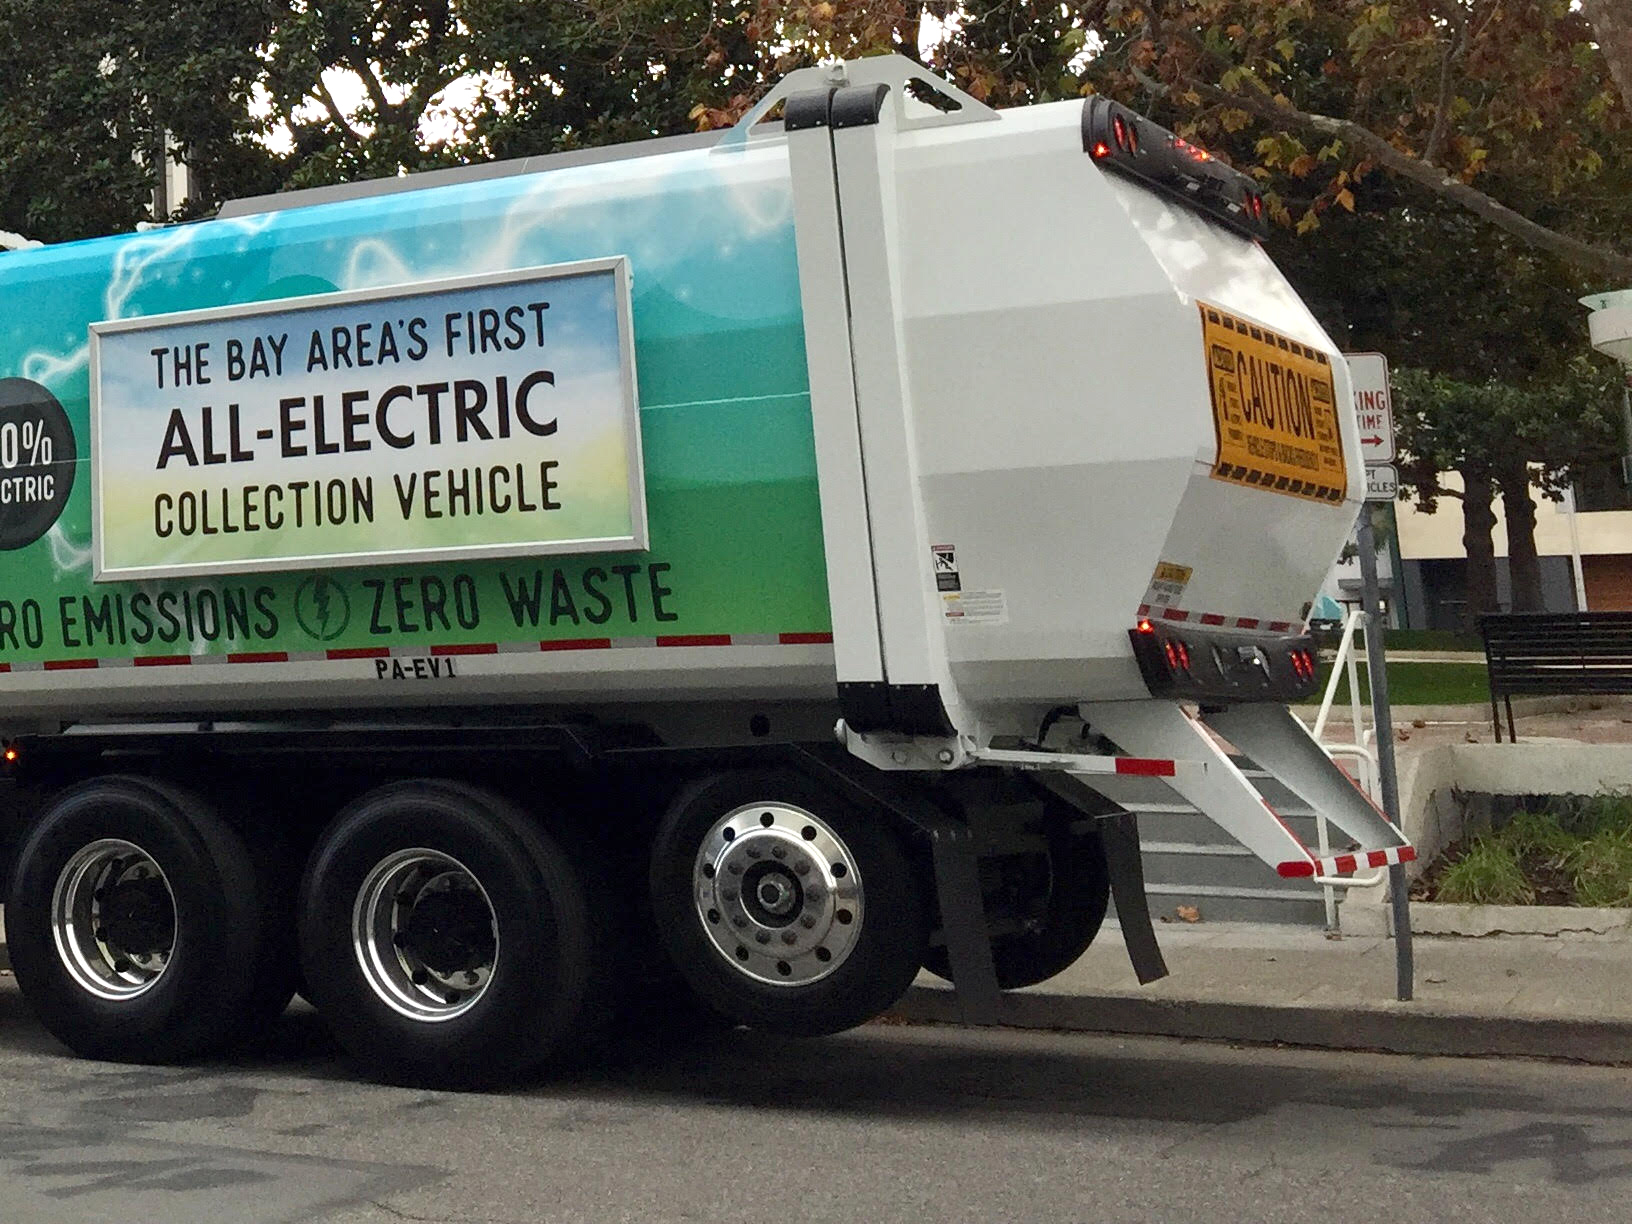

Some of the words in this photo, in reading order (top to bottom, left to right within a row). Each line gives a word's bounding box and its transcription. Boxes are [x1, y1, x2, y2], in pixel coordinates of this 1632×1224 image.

[150, 342, 211, 389] THE
[227, 333, 288, 381] BAY
[306, 317, 428, 373] AREA'S
[445, 302, 550, 357] FIRST
[156, 370, 558, 470] ALL-ELECTRIC
[1236, 350, 1315, 440] CAUTION
[154, 476, 374, 538] COLLECTION
[393, 460, 562, 521] VEHICLE
[59, 586, 280, 648] EMISSIONS
[363, 574, 481, 635] ZERO
[498, 562, 679, 628] WASTE
[374, 657, 457, 680] PA-EV1
